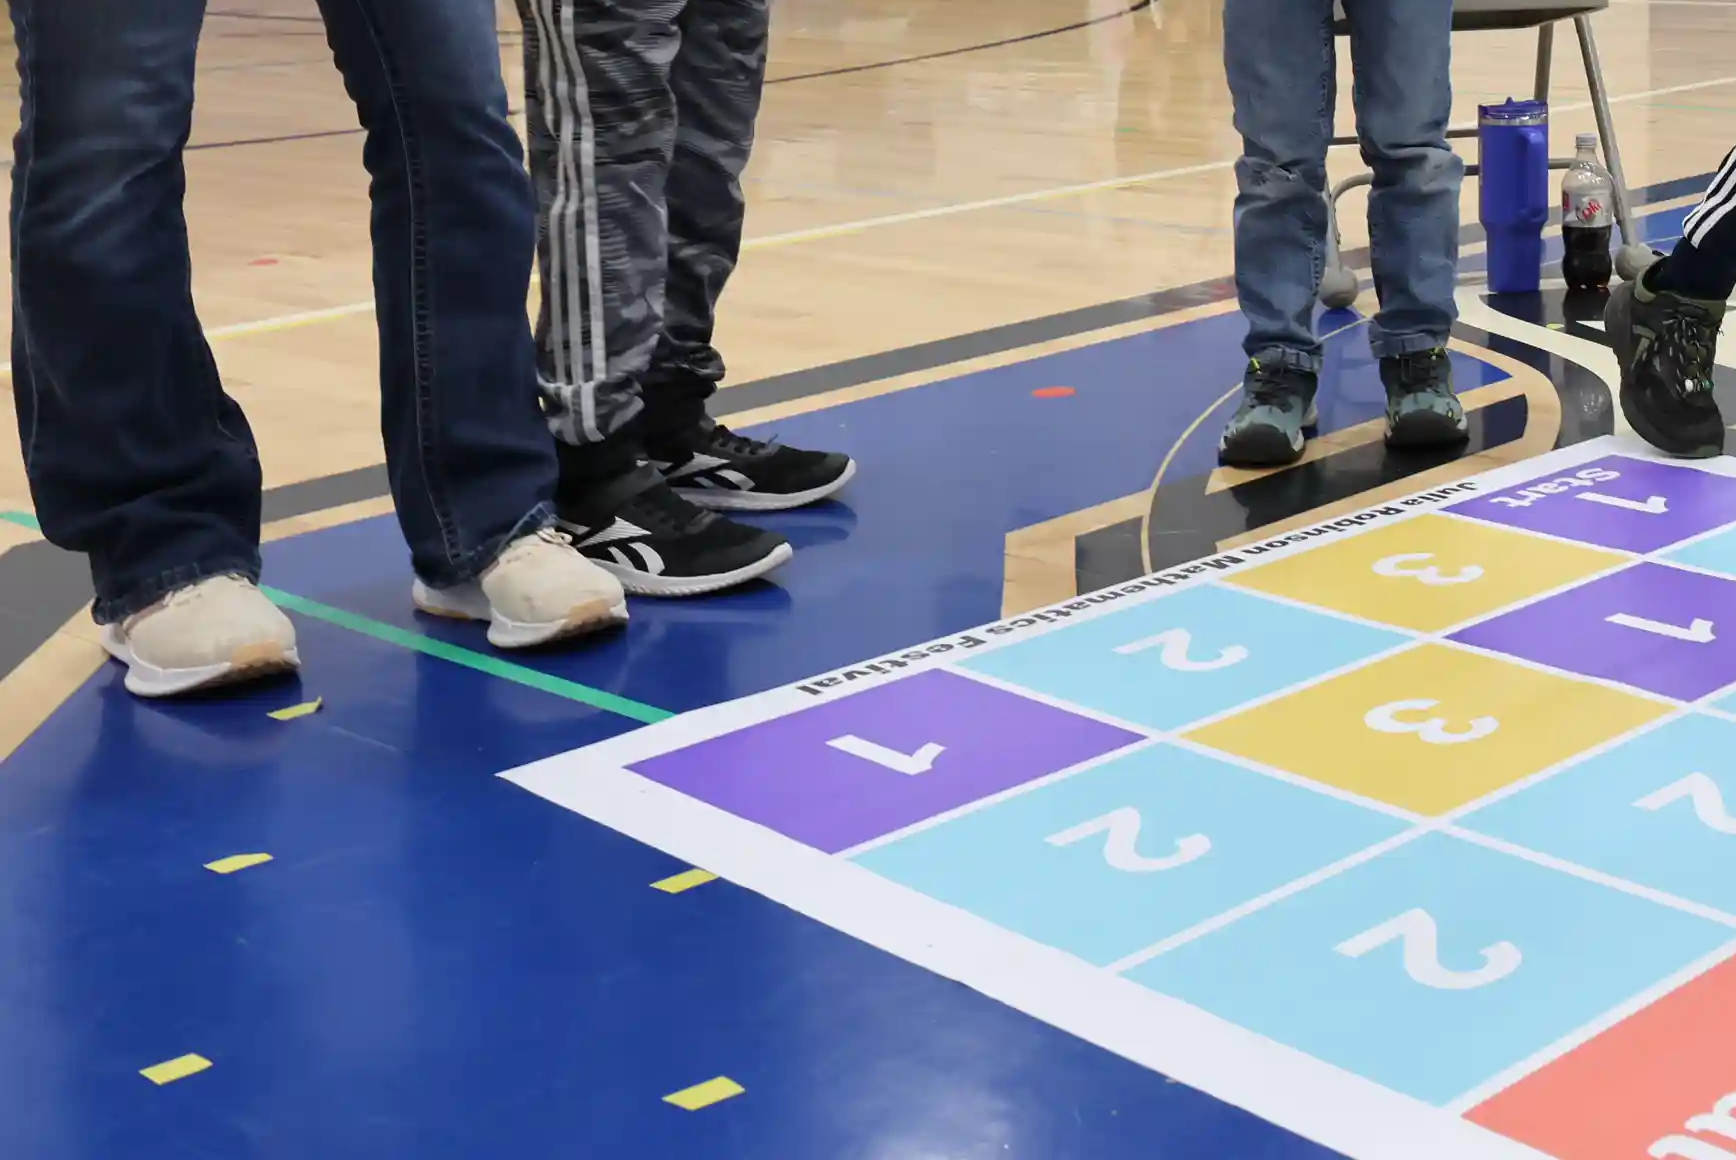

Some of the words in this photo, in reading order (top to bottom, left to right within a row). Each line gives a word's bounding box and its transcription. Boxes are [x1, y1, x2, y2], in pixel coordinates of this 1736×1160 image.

[1400, 480, 1477, 507] Julia
[1490, 467, 1621, 508] Start
[1575, 491, 1669, 514] 1
[1242, 506, 1402, 555] Robinson
[1371, 552, 1484, 586] 3
[984, 551, 1245, 636] Mathematics
[1113, 627, 1250, 672] 2
[1604, 612, 1717, 643] 1
[795, 634, 987, 695] Festival
[1364, 698, 1500, 745] 3
[826, 734, 946, 776] 1
[1045, 806, 1212, 873] 2
[1334, 907, 1523, 990] 2
